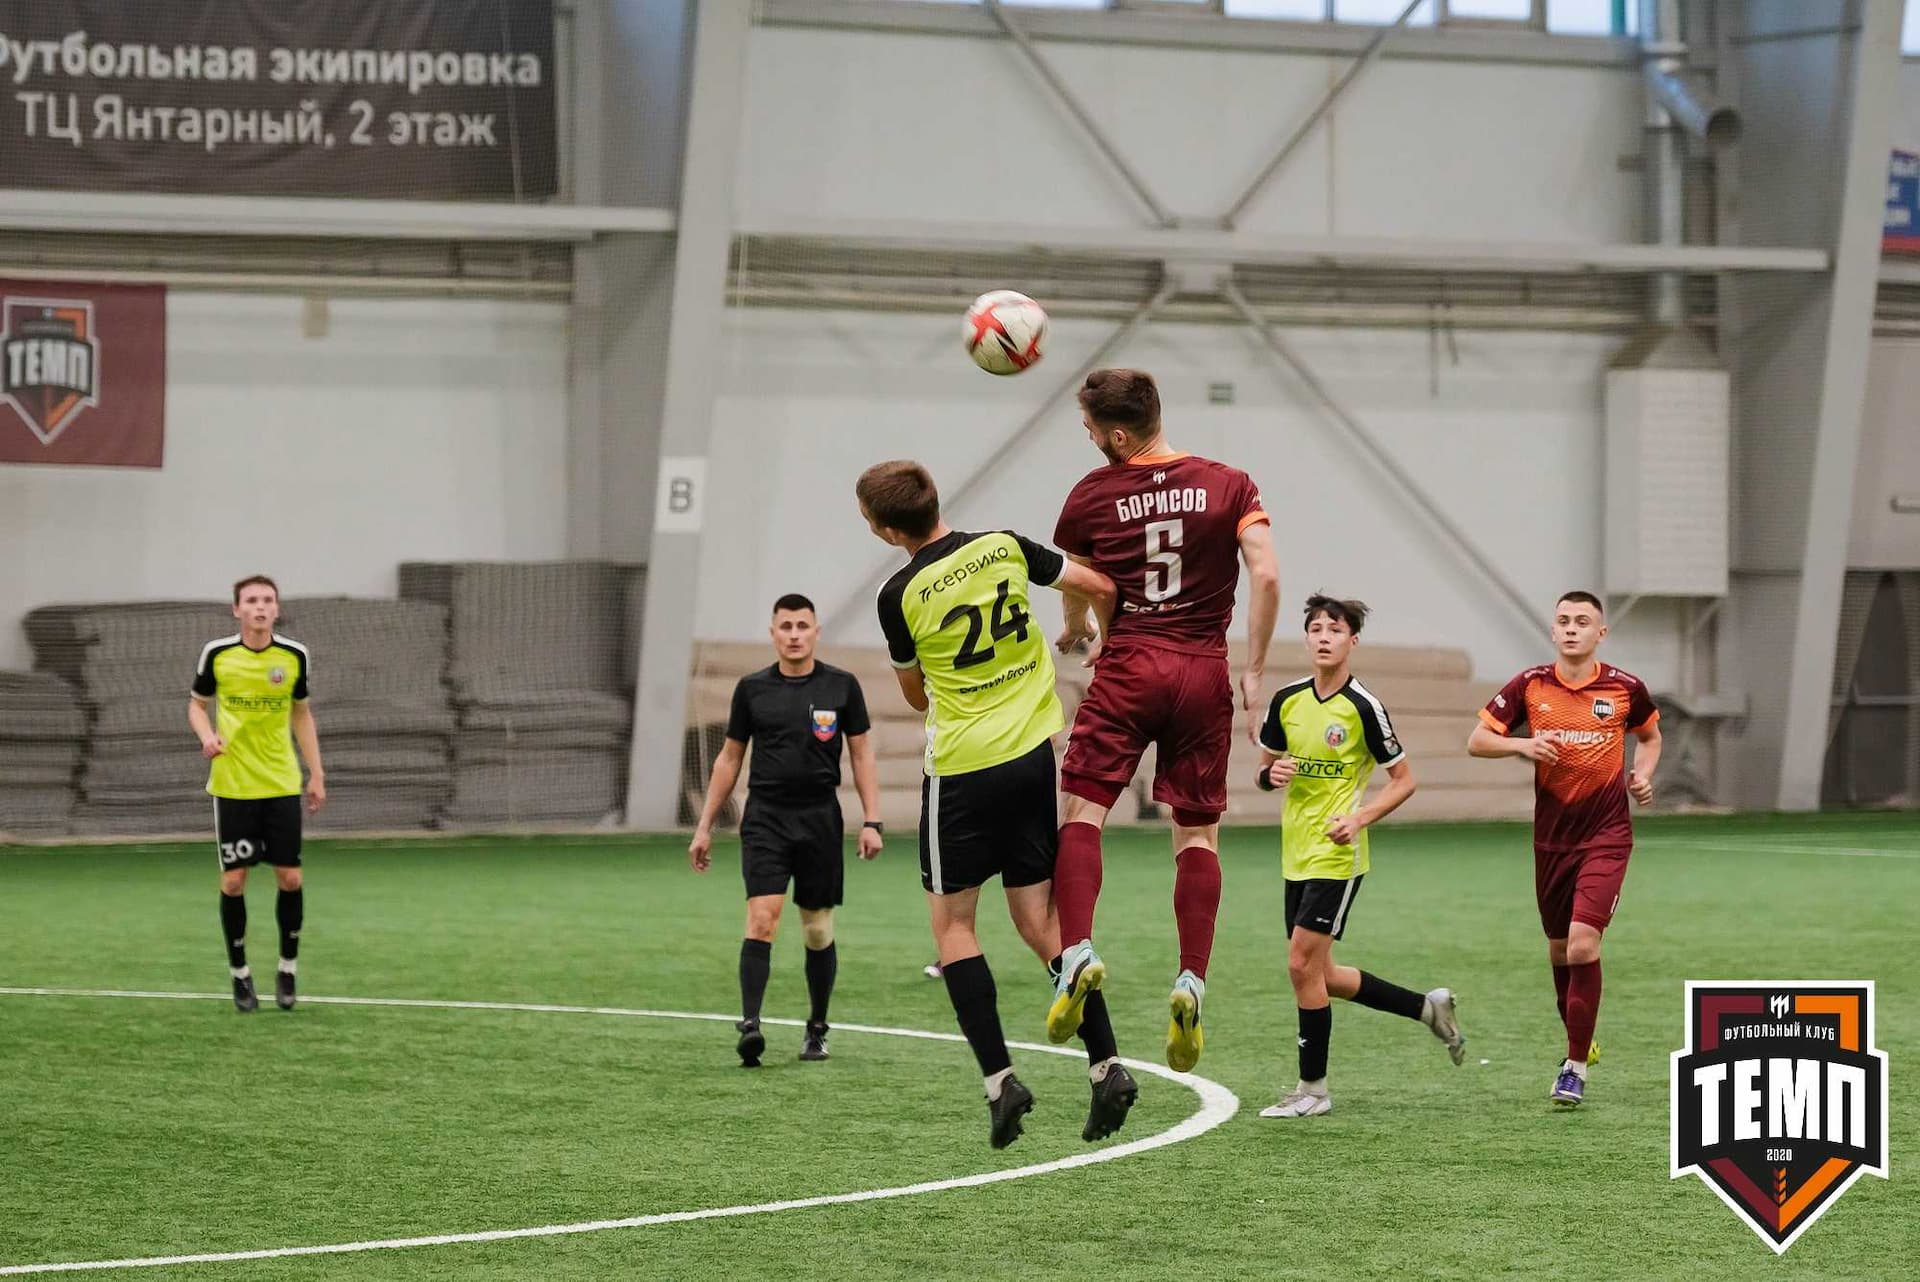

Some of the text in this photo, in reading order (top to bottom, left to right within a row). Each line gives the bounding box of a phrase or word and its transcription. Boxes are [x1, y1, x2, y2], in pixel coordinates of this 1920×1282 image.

[268, 47, 542, 95] экипировка
[15, 91, 499, 152] ТЦ Янтарный, 2 этаж
[7, 339, 89, 391] ТЕМП
[1115, 487, 1207, 523] БОРИСОВ
[932, 546, 1010, 594] сервико
[1144, 518, 1184, 603] 5
[939, 578, 1030, 671] 24
[221, 838, 254, 864] 30
